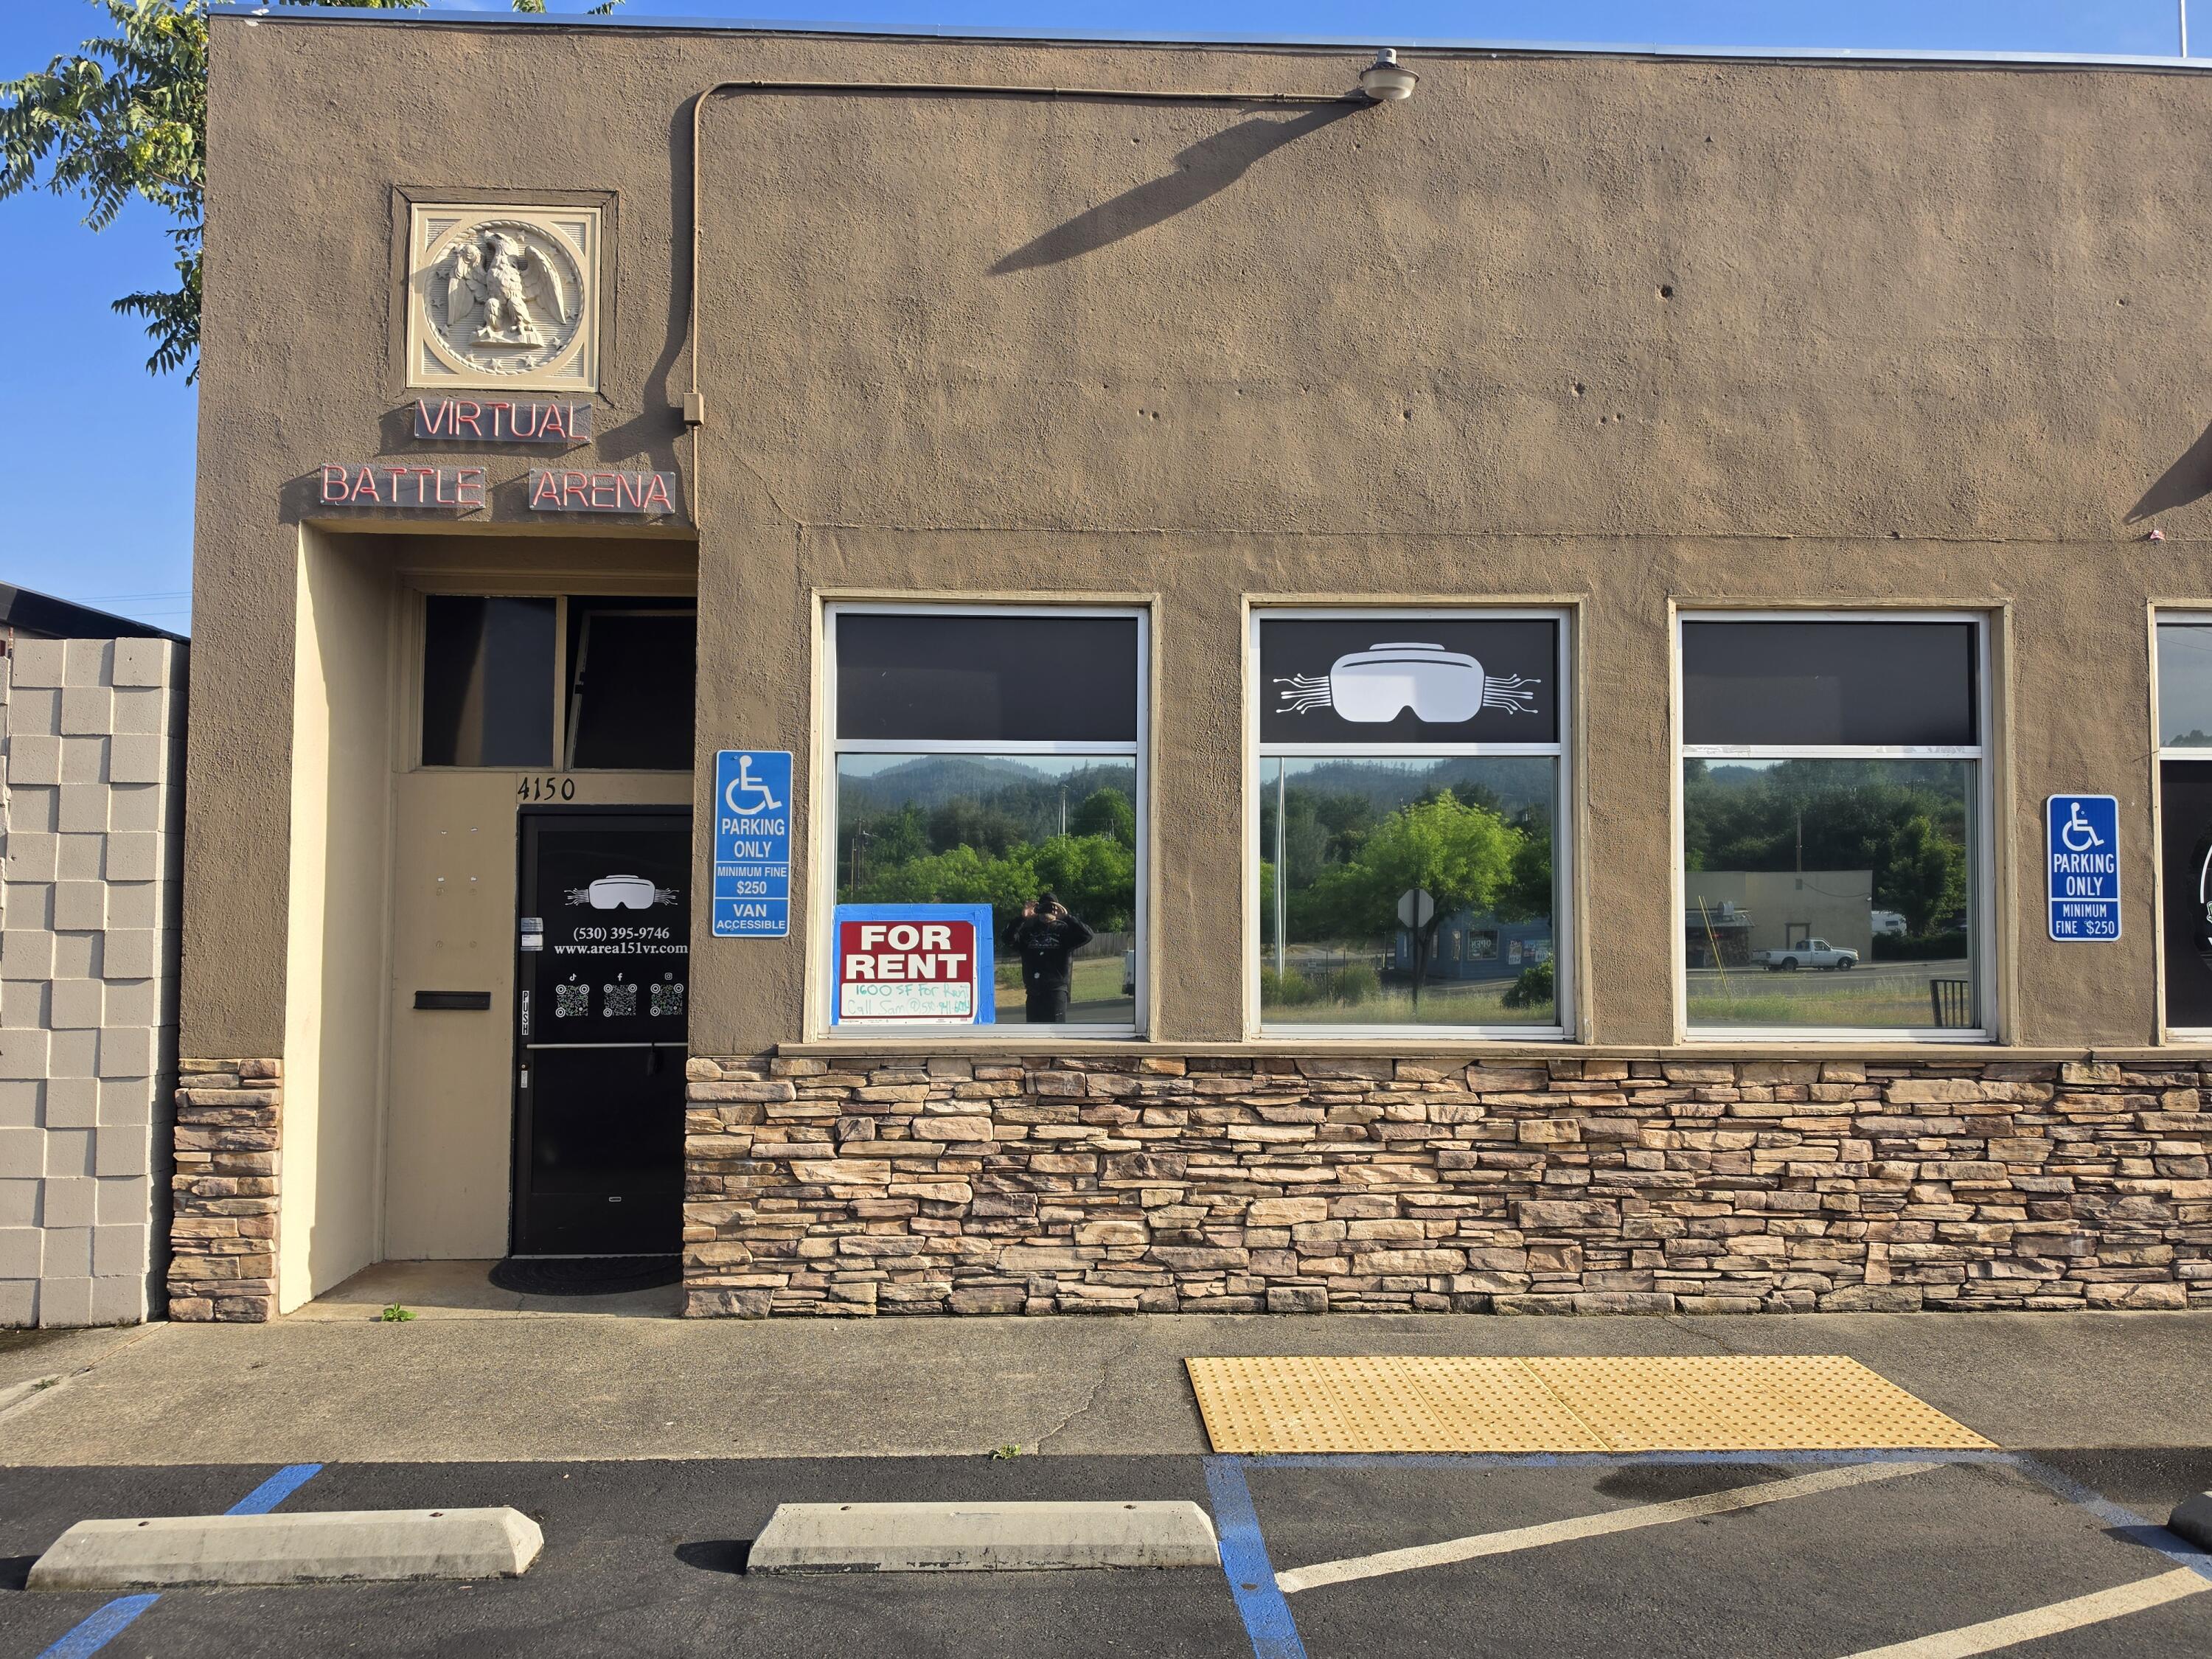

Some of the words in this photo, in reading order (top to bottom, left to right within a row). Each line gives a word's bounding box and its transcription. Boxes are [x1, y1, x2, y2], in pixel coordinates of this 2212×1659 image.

[417, 399, 588, 439] VIRTUAL
[322, 465, 482, 506] BATTLE
[532, 471, 671, 509] ARENA
[517, 776, 575, 801] 4150
[721, 818, 785, 835] PARKING
[734, 841, 772, 858] ONLY
[717, 866, 762, 877] MINIMUM
[765, 867, 787, 877] FINE
[2053, 853, 2115, 874] PARKING
[736, 880, 768, 896] $250
[2066, 876, 2103, 897] ONLY
[733, 904, 768, 917] VAN
[2063, 904, 2107, 918] MINIMUM
[716, 920, 786, 930] ACCESSIBLE
[2056, 921, 2078, 934] FINE
[2085, 920, 2115, 936] $250
[573, 927, 607, 942] (530)
[610, 927, 670, 940] 395-9746
[860, 925, 952, 950] FOR
[554, 942, 689, 955] www.area151vr.com
[846, 953, 967, 979] RENT
[856, 984, 892, 996] 1600
[896, 984, 914, 996] SF
[848, 999, 872, 1015] Call
